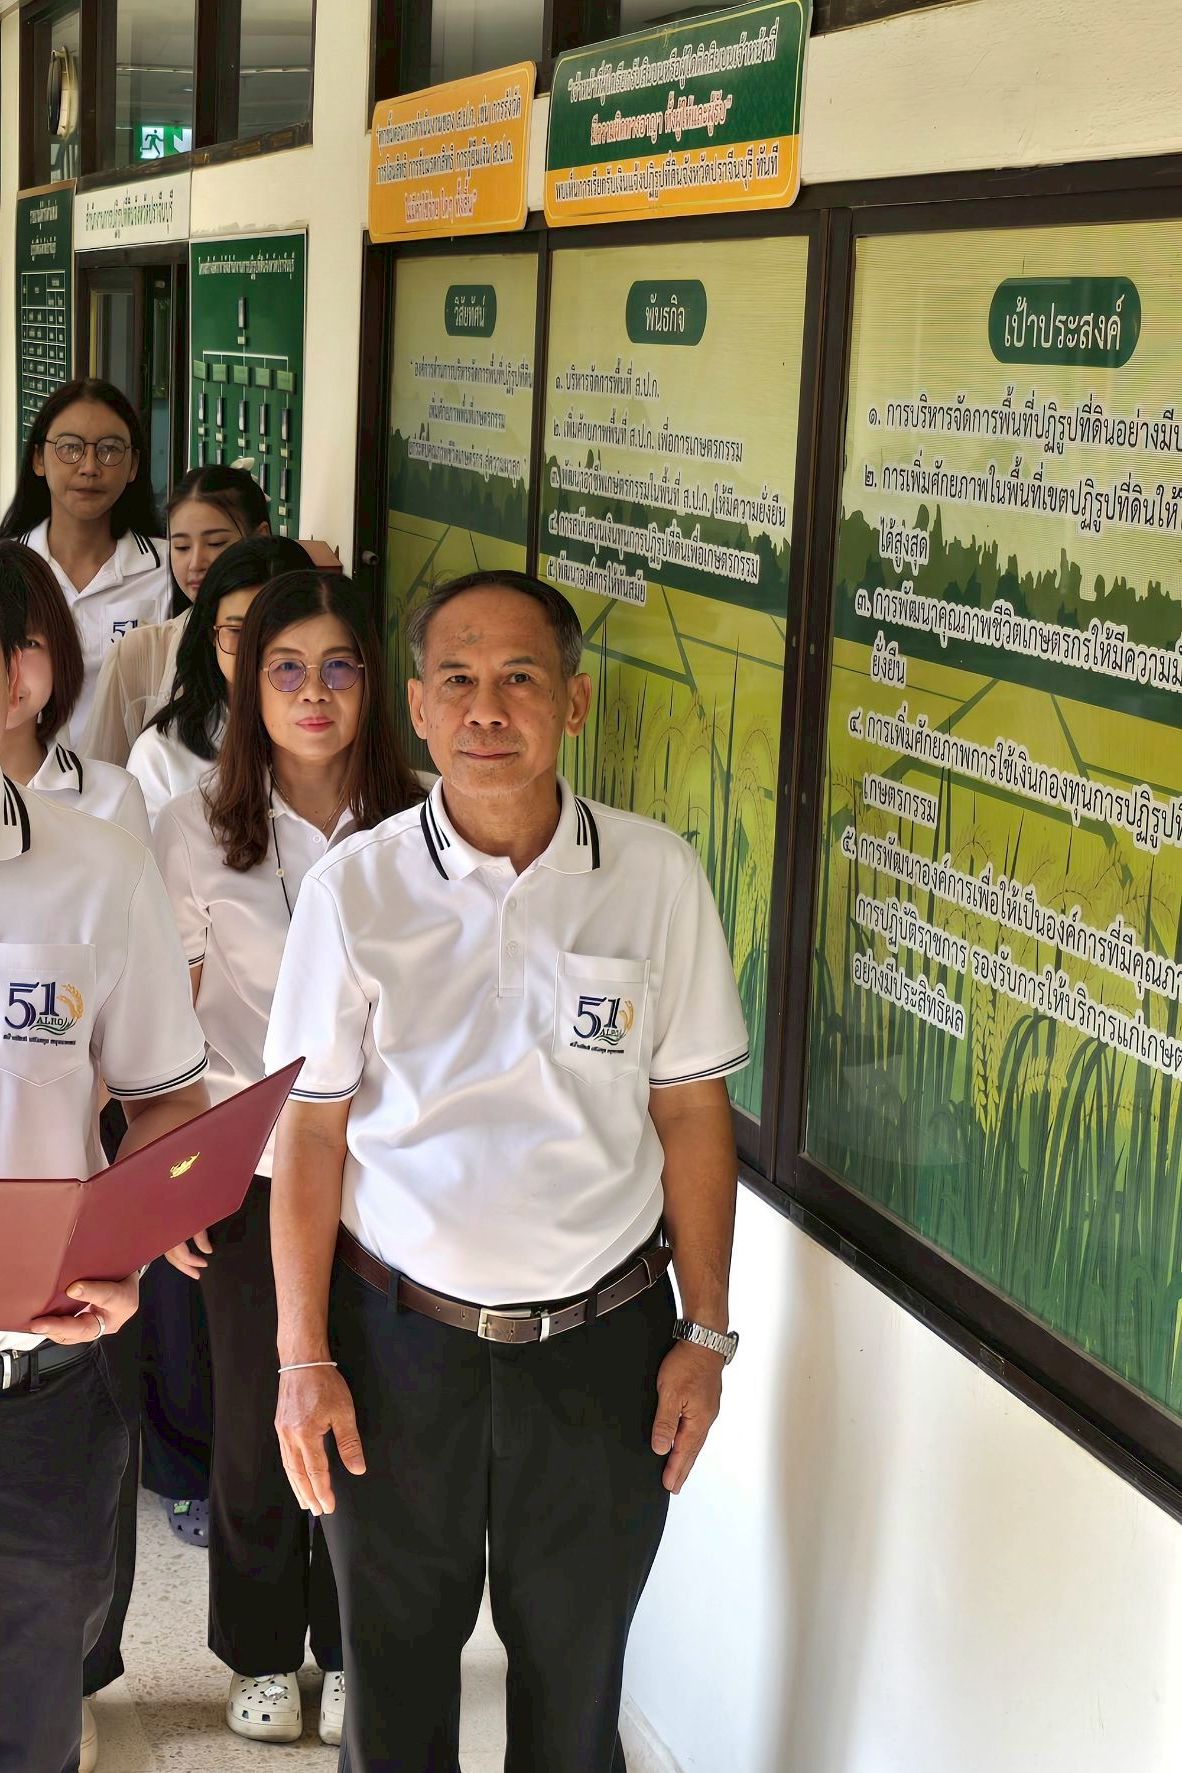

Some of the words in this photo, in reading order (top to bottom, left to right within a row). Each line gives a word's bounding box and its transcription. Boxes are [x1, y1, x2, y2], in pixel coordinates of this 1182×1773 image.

[454, 296, 485, 327] วิสัยทัศน์
[645, 293, 685, 332] พันธกิจ
[1004, 294, 1125, 350] เป้าประสงค์
[635, 372, 659, 397] ส.ป.ก.
[630, 424, 654, 449] ส.ป.ก.
[658, 417, 743, 462] เพื่อการเกษตรกรรม
[683, 485, 710, 512] ส.ป.ก.
[714, 483, 786, 527] ให้มีความยั่งยืน
[882, 450, 1182, 533] การเพิ่มศักยภาพในพื้นที่เขตปฏิรูปที่ดินให้
[881, 516, 928, 571] ได้สูงสุด
[872, 634, 905, 684] ยั่งยืน
[864, 776, 936, 824] เกษตรกรรม
[857, 898, 966, 972] การปฏิบัติราชการ
[5, 982, 59, 1030] 51
[573, 996, 621, 1039] 51
[854, 953, 964, 1034] อย่างมีประสิทธิผล
